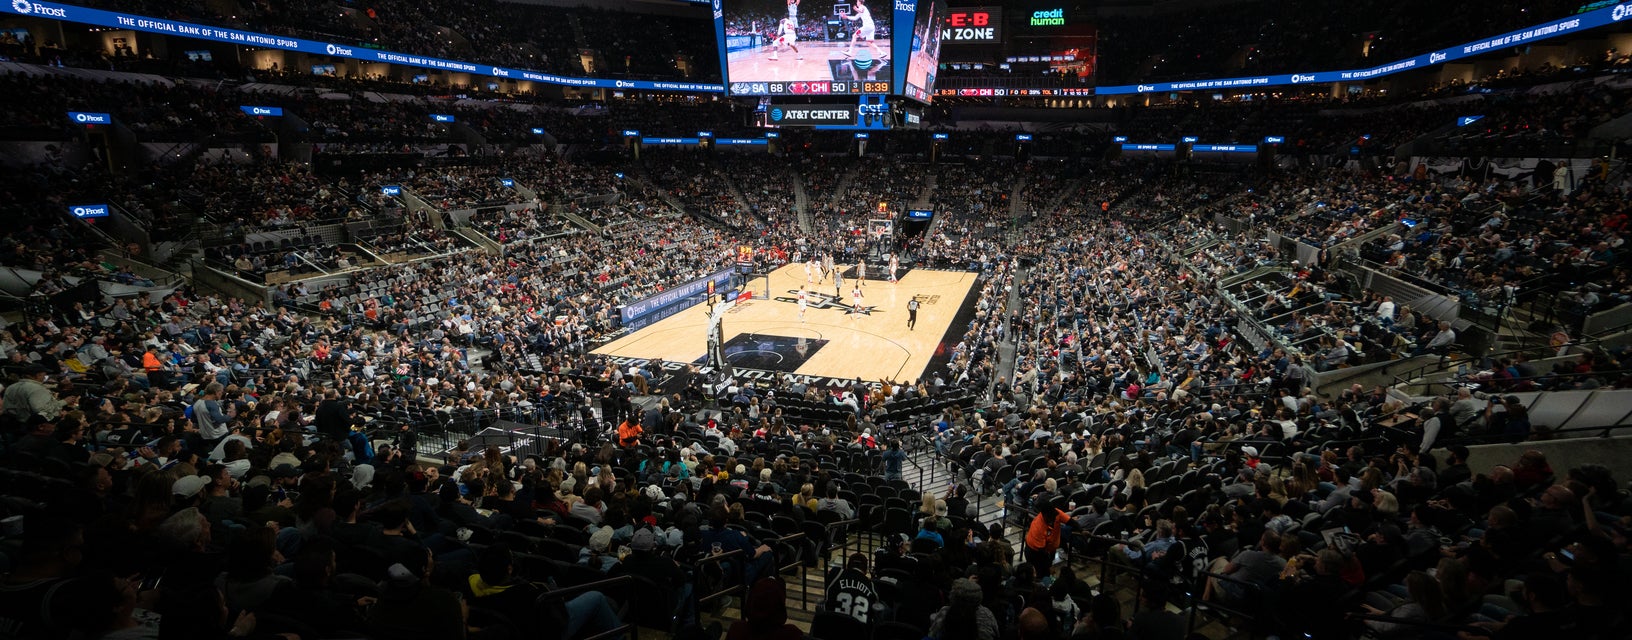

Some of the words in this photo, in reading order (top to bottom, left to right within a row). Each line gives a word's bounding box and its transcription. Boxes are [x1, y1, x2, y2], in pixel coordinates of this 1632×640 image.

[33, 3, 66, 17] Frost
[895, 0, 915, 12] Frost
[1034, 8, 1063, 18] credit
[1030, 17, 1064, 25] human
[117, 16, 135, 26] THE
[138, 20, 176, 31] OFFICIAL
[179, 26, 199, 34] BANK
[214, 30, 228, 38] THE
[230, 33, 244, 41] SAN
[247, 35, 275, 45] ANTONIO
[277, 39, 298, 48] SPURS
[954, 28, 994, 40] ZONE
[1472, 42, 1490, 52] OFFICIAL
[1491, 38, 1504, 47] BANK
[1504, 36, 1512, 44] OF
[1512, 34, 1522, 42] THE
[1522, 31, 1533, 40] SAN
[1534, 24, 1558, 36] ANTONIO
[1559, 19, 1580, 30] SPURS
[336, 47, 352, 56] Frost
[1435, 53, 1446, 61] Frost
[752, 84, 765, 92] SA
[770, 84, 783, 92] 68
[812, 84, 827, 92] CHI
[832, 83, 845, 92] 50
[864, 82, 888, 92] 8:39
[87, 114, 104, 122] Frost
[785, 110, 808, 120] AT&T
[810, 110, 849, 119] CENTER
[634, 304, 646, 315] Frost
[650, 298, 659, 308] THE
[660, 290, 678, 305] OFFICIAL
[679, 284, 690, 299] BANK
[840, 578, 873, 598] ELLIOTT
[834, 592, 870, 624] 32
